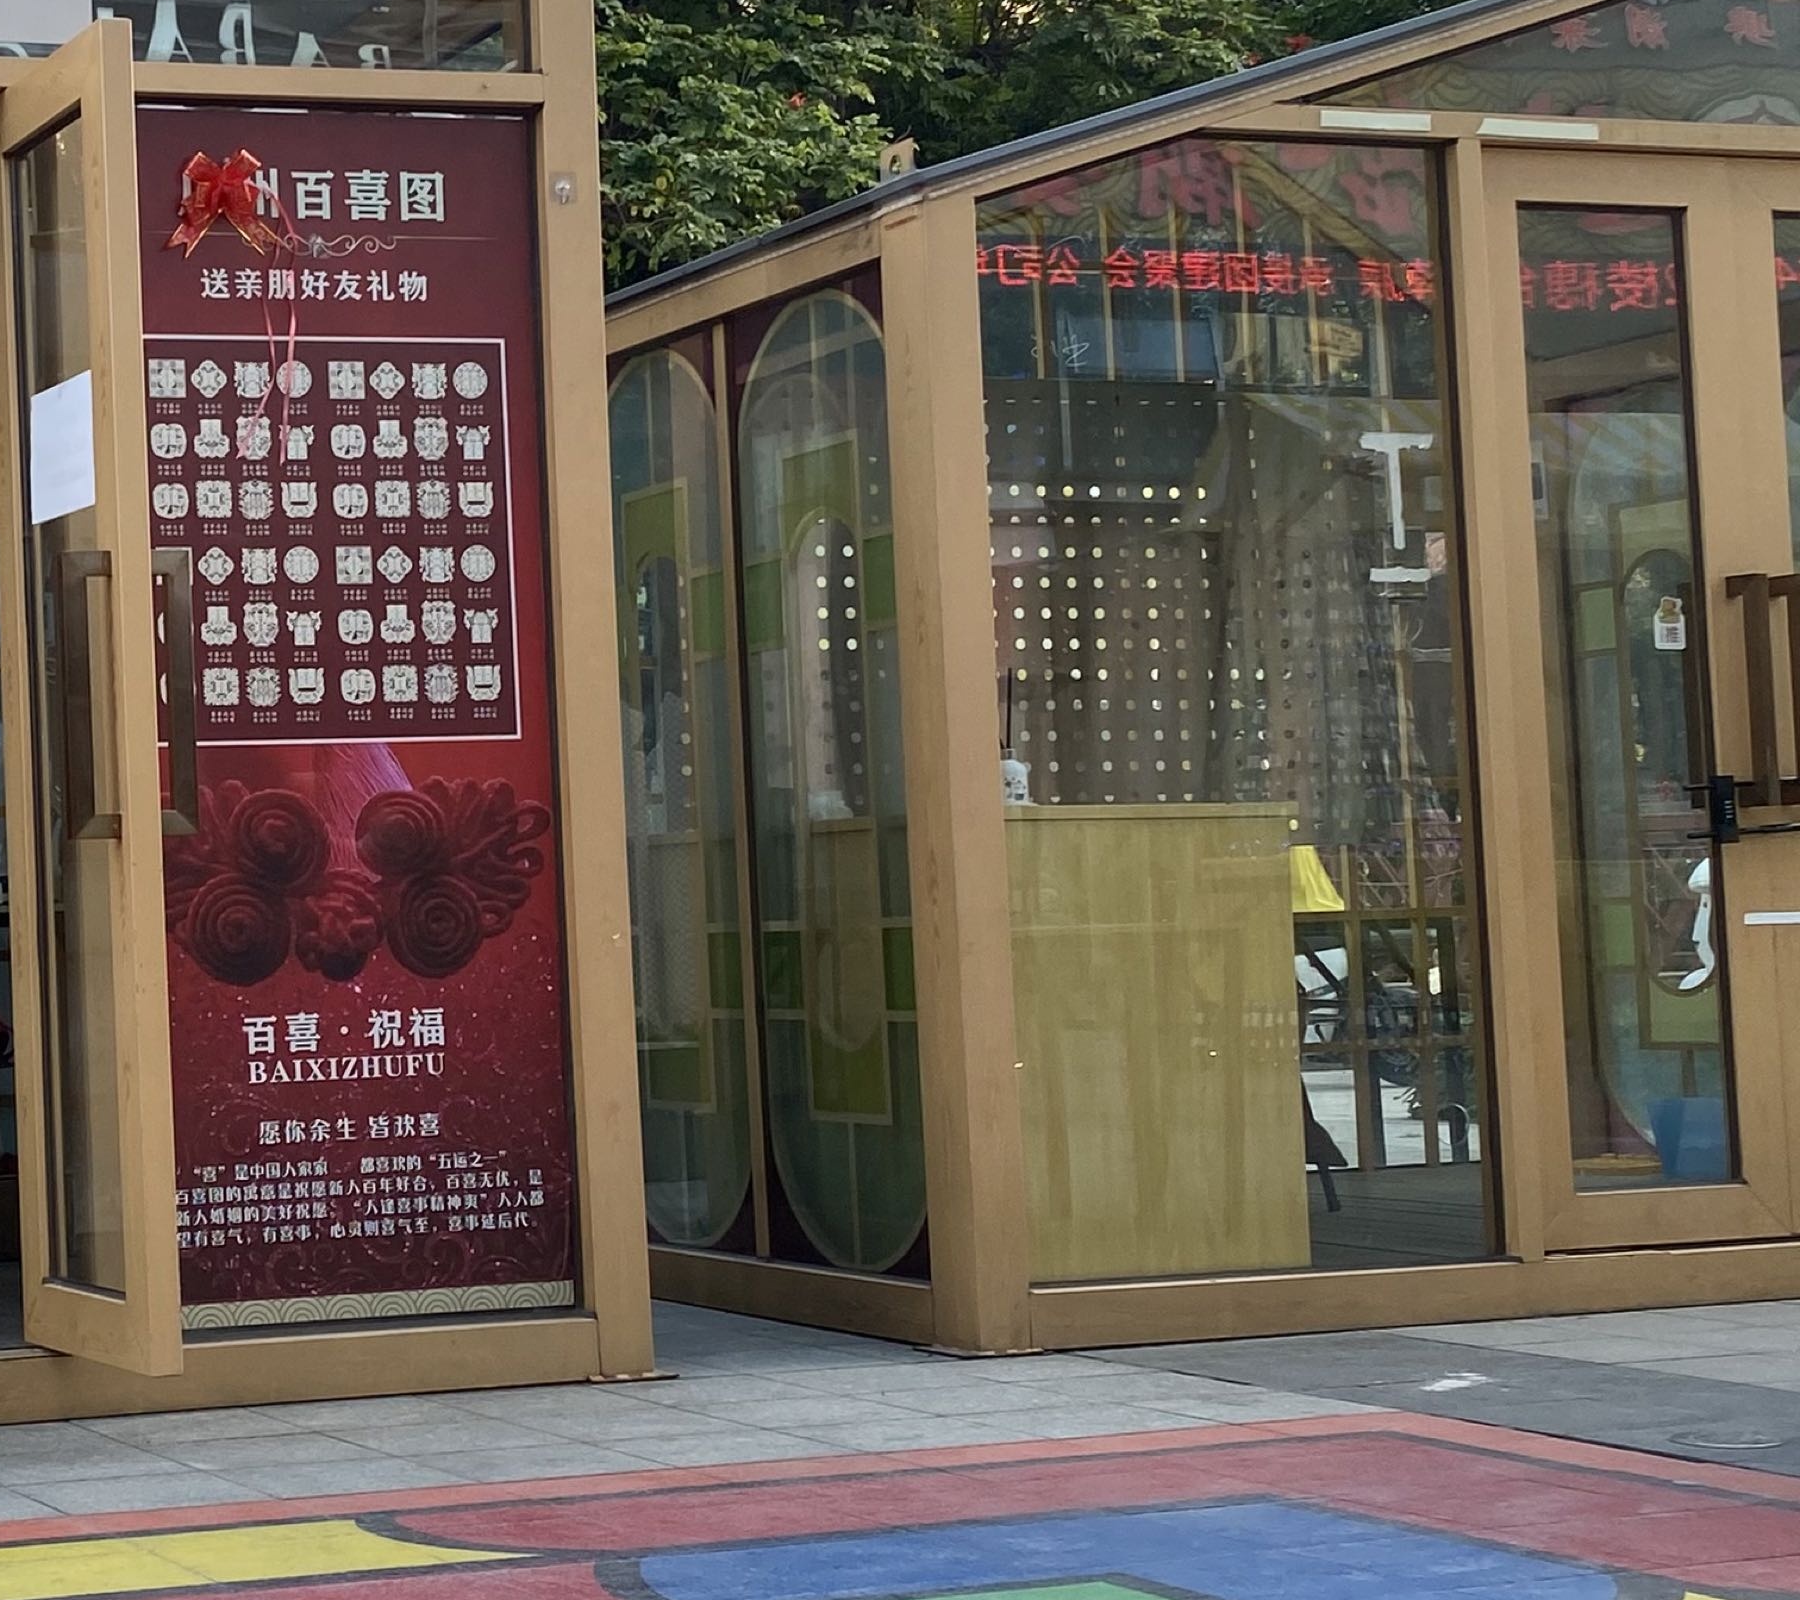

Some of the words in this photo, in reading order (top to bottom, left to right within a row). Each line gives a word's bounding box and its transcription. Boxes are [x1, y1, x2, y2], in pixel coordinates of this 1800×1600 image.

[200, 268, 429, 301] 送亲朋好友礼物
[248, 1052, 445, 1084] BAIXIZHUFU
[259, 1117, 357, 1145] 愿你余生
[368, 1112, 440, 1139] 皆欢喜
